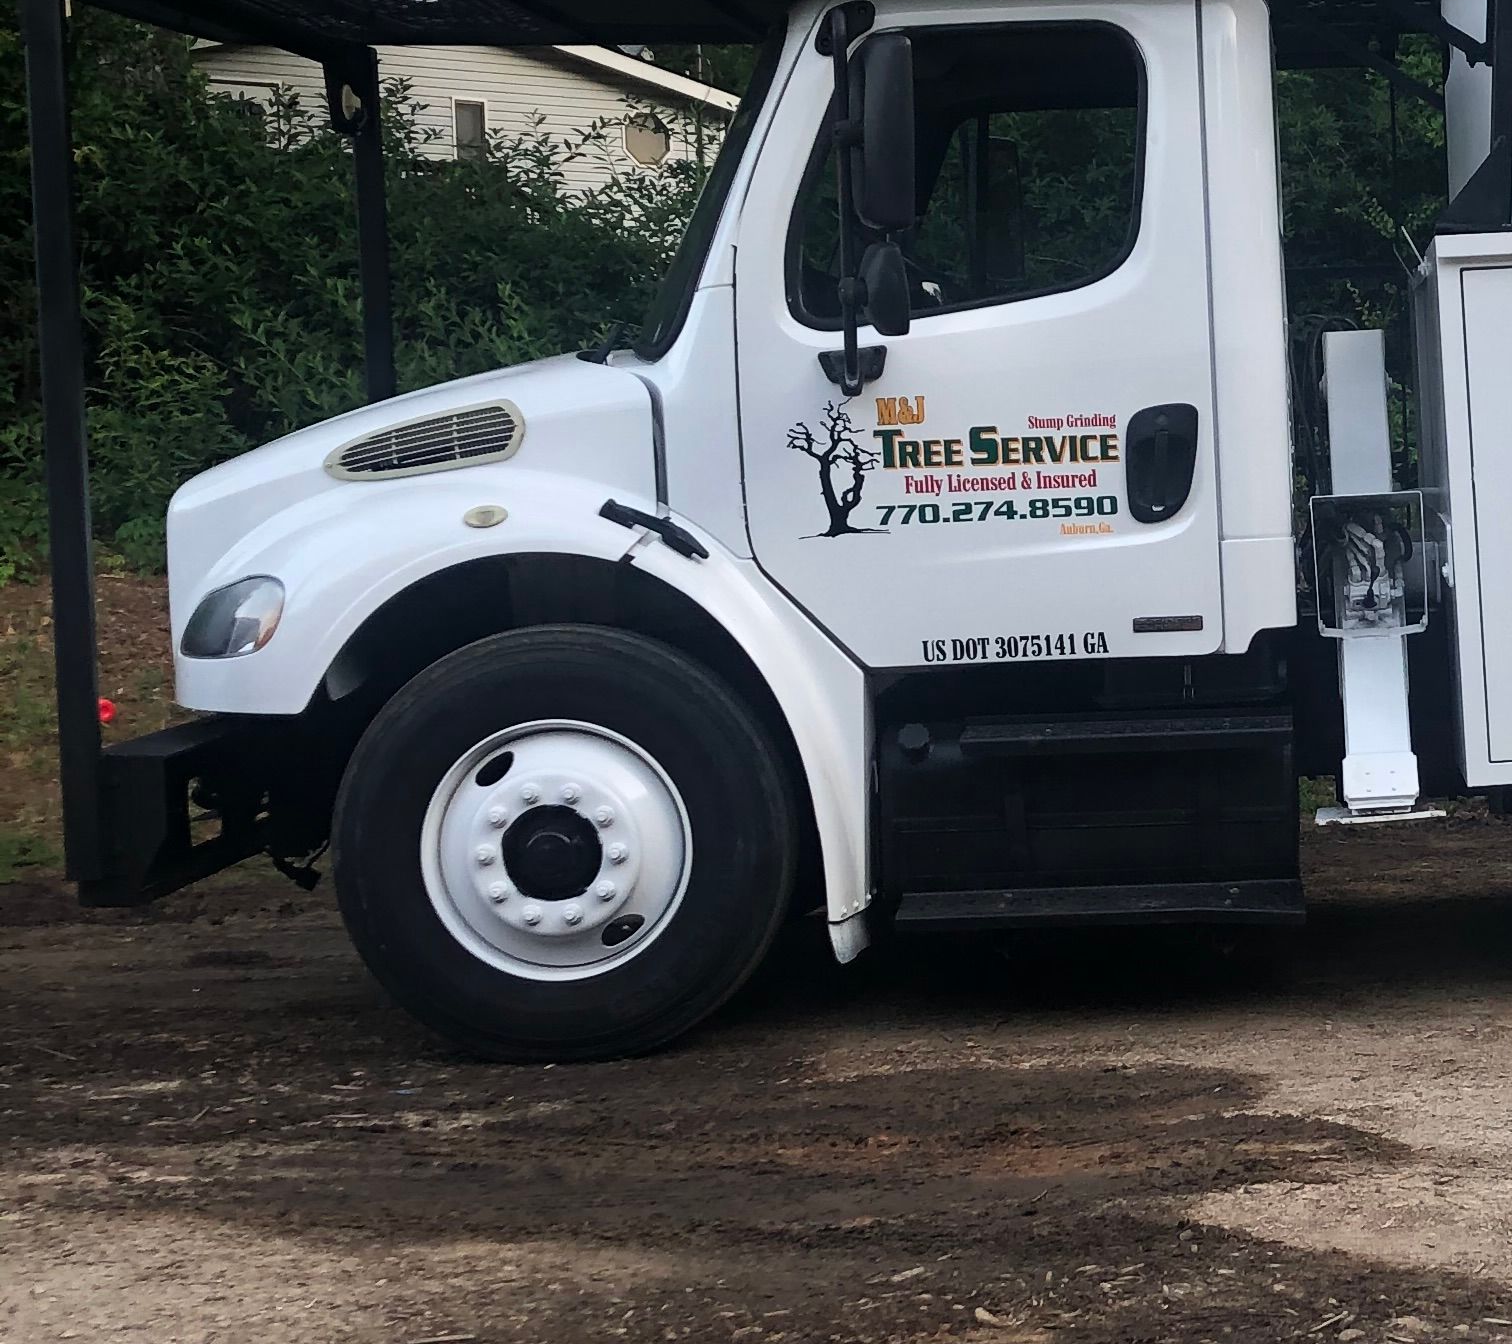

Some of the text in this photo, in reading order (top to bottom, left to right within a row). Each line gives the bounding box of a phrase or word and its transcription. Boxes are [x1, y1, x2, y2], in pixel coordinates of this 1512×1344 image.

[876, 396, 925, 426] M&J
[1028, 413, 1117, 431] Stump Grinding
[873, 426, 1120, 469] TREE SERVICE
[904, 469, 1098, 496] Fully Licensed & Insured
[876, 496, 1118, 525] 770.274.8590
[922, 631, 1110, 662] US DOT 3075141 GA
